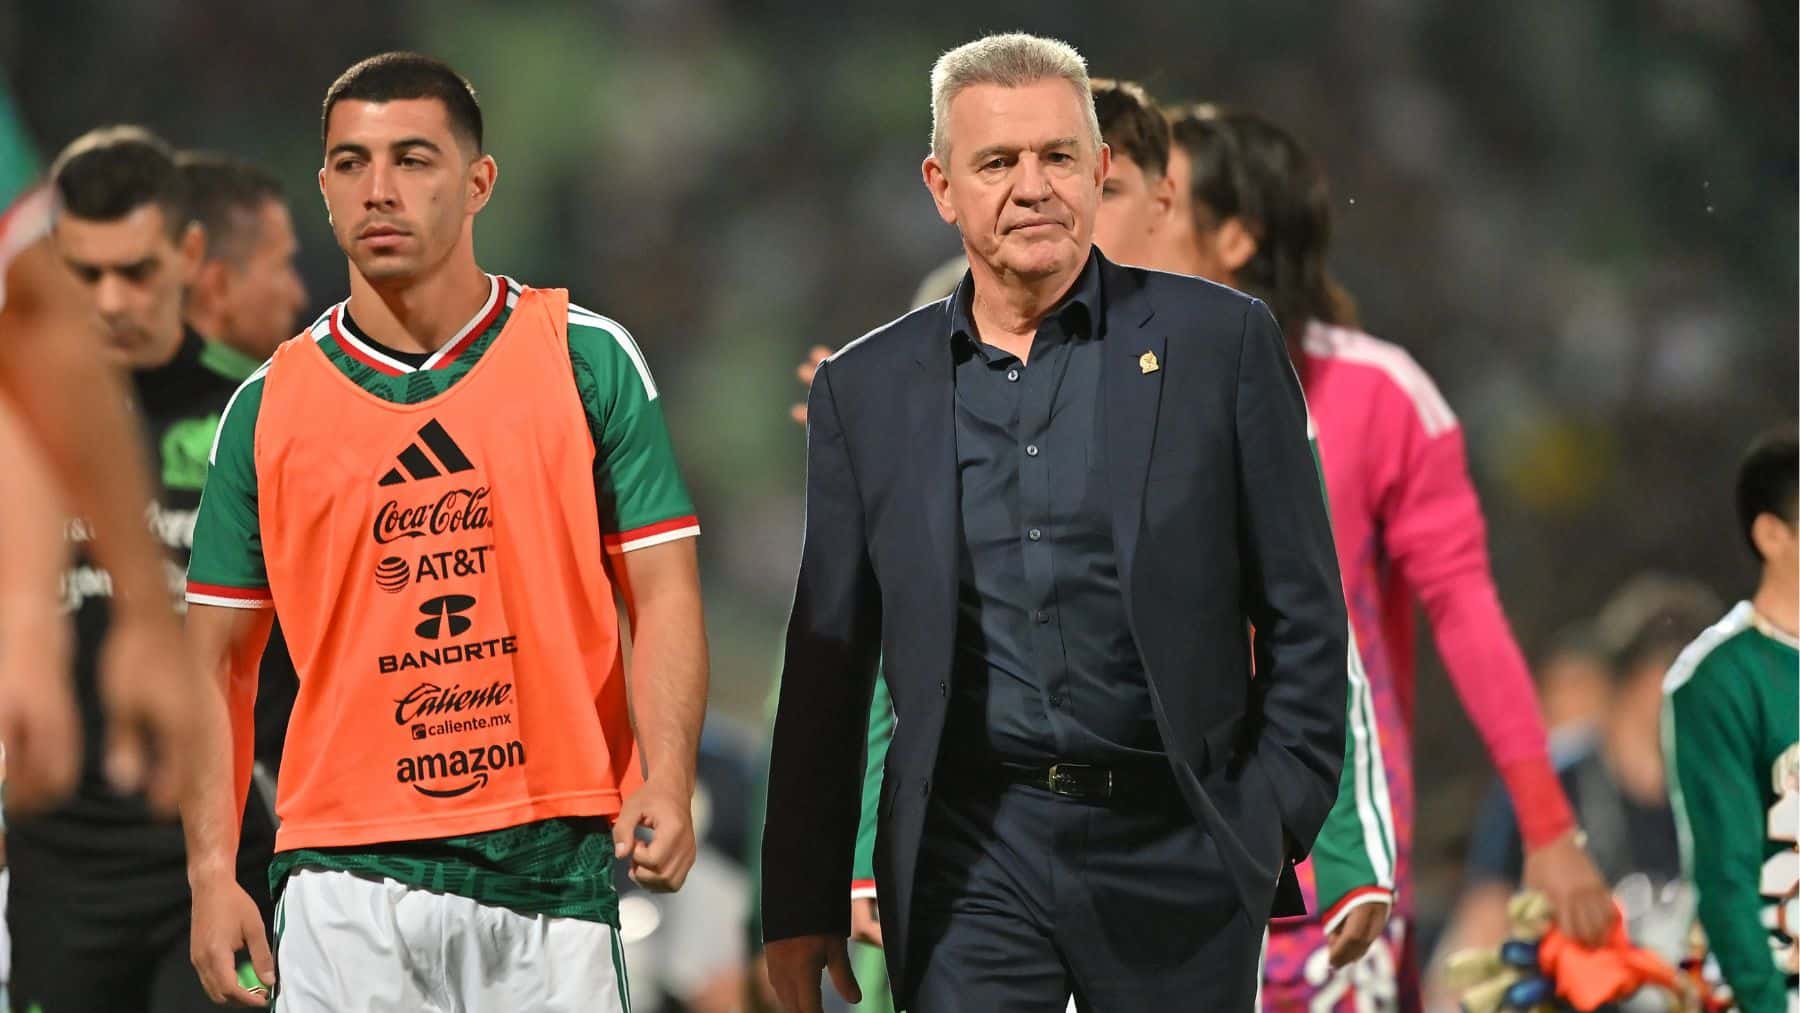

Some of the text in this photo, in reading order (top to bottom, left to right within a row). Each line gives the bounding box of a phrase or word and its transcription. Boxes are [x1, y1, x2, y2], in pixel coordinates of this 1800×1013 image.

[415, 545, 488, 583] AT&T
[378, 635, 518, 674] BANORTE
[394, 681, 512, 726] Caliente
[428, 713, 512, 736] caliente.mx
[396, 740, 526, 783] amazon
